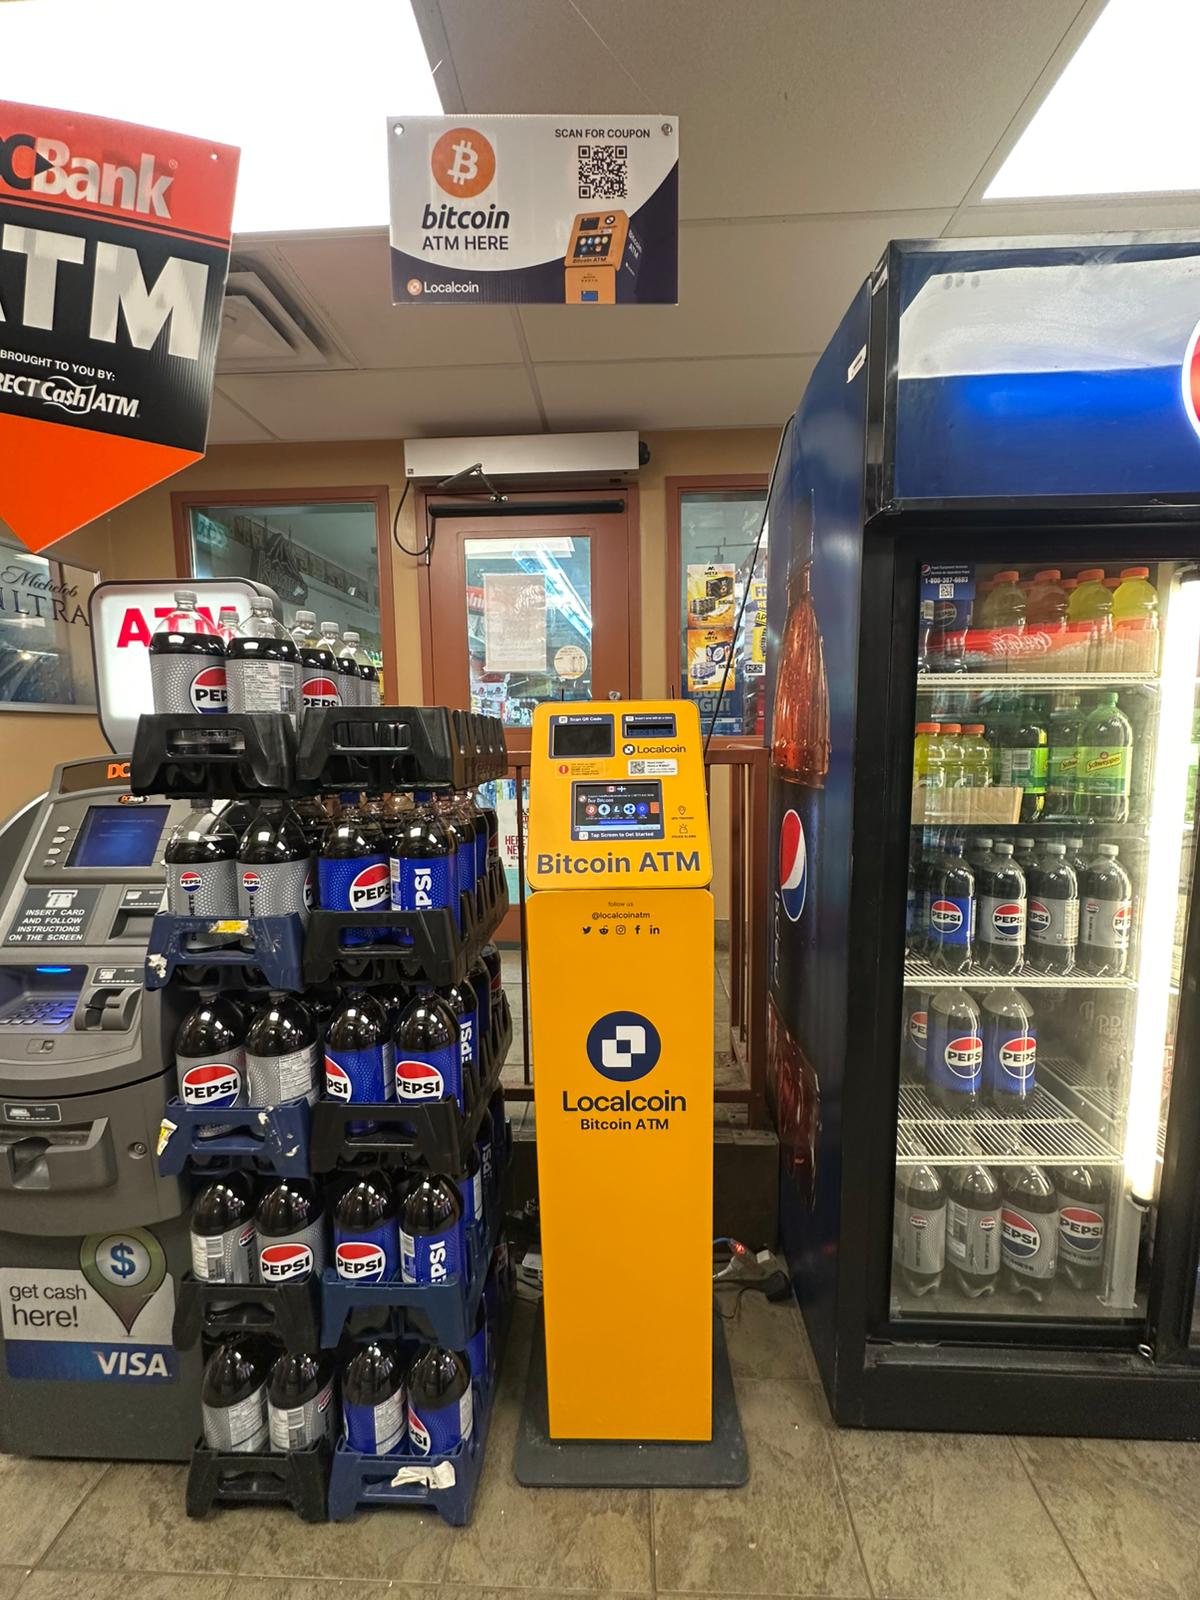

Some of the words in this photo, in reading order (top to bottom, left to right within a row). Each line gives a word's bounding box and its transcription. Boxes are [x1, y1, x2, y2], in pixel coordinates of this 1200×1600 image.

[554, 128, 583, 139] SCAN
[585, 128, 605, 138] FOR
[607, 128, 650, 139] COUPON
[0, 132, 174, 219] CBank
[422, 203, 510, 230] bitcoin
[422, 236, 459, 251] ATM
[464, 235, 509, 250] HERE
[0, 223, 209, 361] TM
[424, 281, 479, 294] Localcoin
[0, 349, 53, 367] BROUGHT
[55, 360, 69, 371] TO
[72, 363, 95, 377] YOU
[97, 369, 116, 381] BY:
[92, 392, 140, 418] ATM
[1, 565, 78, 597] Michelob
[195, 688, 228, 702] PEP
[637, 744, 686, 754] Localcoin
[107, 762, 131, 779] DC
[537, 852, 630, 875] Bitcoin
[639, 851, 701, 873] ATM
[353, 883, 390, 903] PEPS
[414, 868, 432, 910] PSI
[592, 911, 650, 921] @localcoinatm
[932, 910, 961, 922] PEPSI
[994, 915, 1024, 924] PEPS
[947, 1051, 982, 1062] PEPS
[1003, 1052, 1035, 1062] PEPS
[185, 1078, 238, 1099] PEPSI
[328, 1079, 348, 1094] PSI
[397, 1080, 440, 1094] PEPSI
[562, 1090, 687, 1112] Localcoin
[580, 1118, 632, 1130] Bitcoin
[635, 1118, 669, 1130] ATM
[1002, 1224, 1038, 1246] EPSI
[1060, 1217, 1103, 1237] PEPSI
[262, 1256, 310, 1276] PEPSI
[337, 1257, 383, 1274] PEPSI
[9, 1284, 39, 1302] get
[43, 1284, 87, 1300] cash
[12, 1304, 79, 1328] here!
[96, 1351, 168, 1377] VISA
